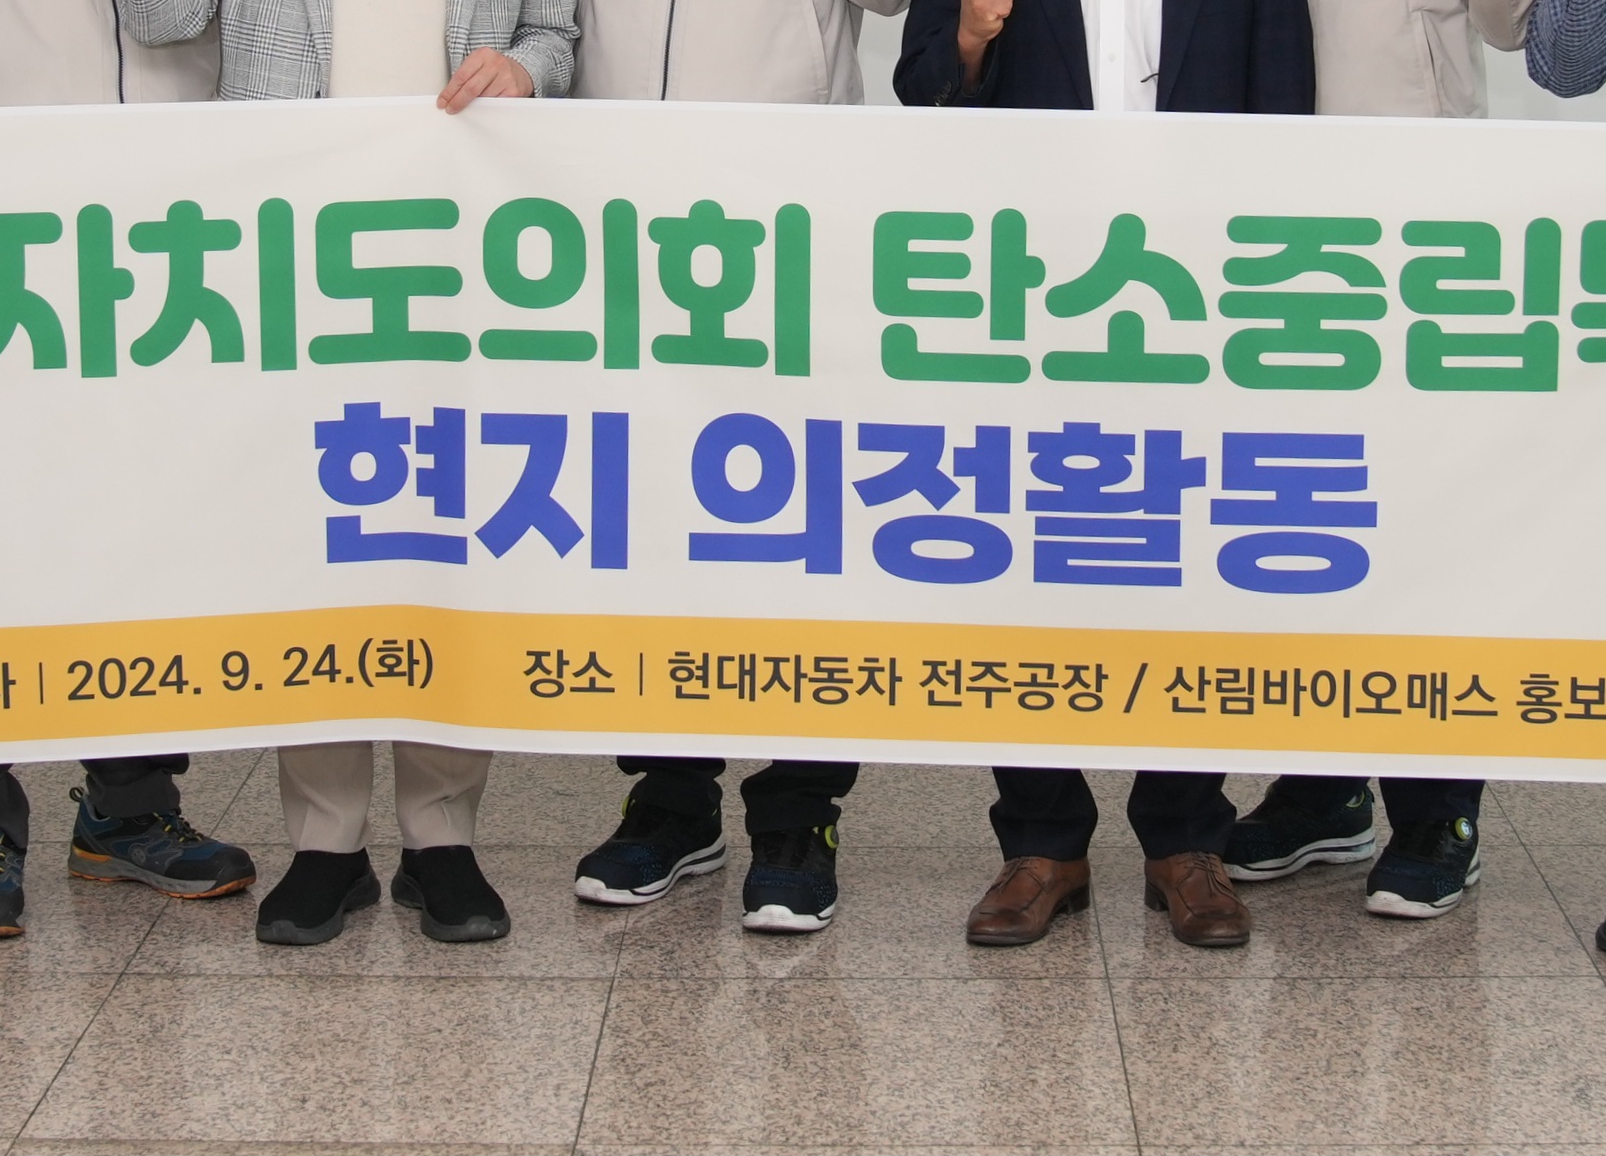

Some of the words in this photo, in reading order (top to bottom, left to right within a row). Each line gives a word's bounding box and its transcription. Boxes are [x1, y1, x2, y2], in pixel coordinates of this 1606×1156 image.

[314, 402, 629, 570] 현지
[689, 413, 1379, 594] 의정활동
[67, 654, 203, 702] 2024.
[221, 650, 264, 692] 9.
[282, 637, 434, 690] 24.(화)
[523, 649, 616, 698] 장소
[667, 651, 903, 707] 현대자동차
[919, 659, 1109, 713] 전주공장
[1164, 666, 1498, 722] 산림바이오매스
